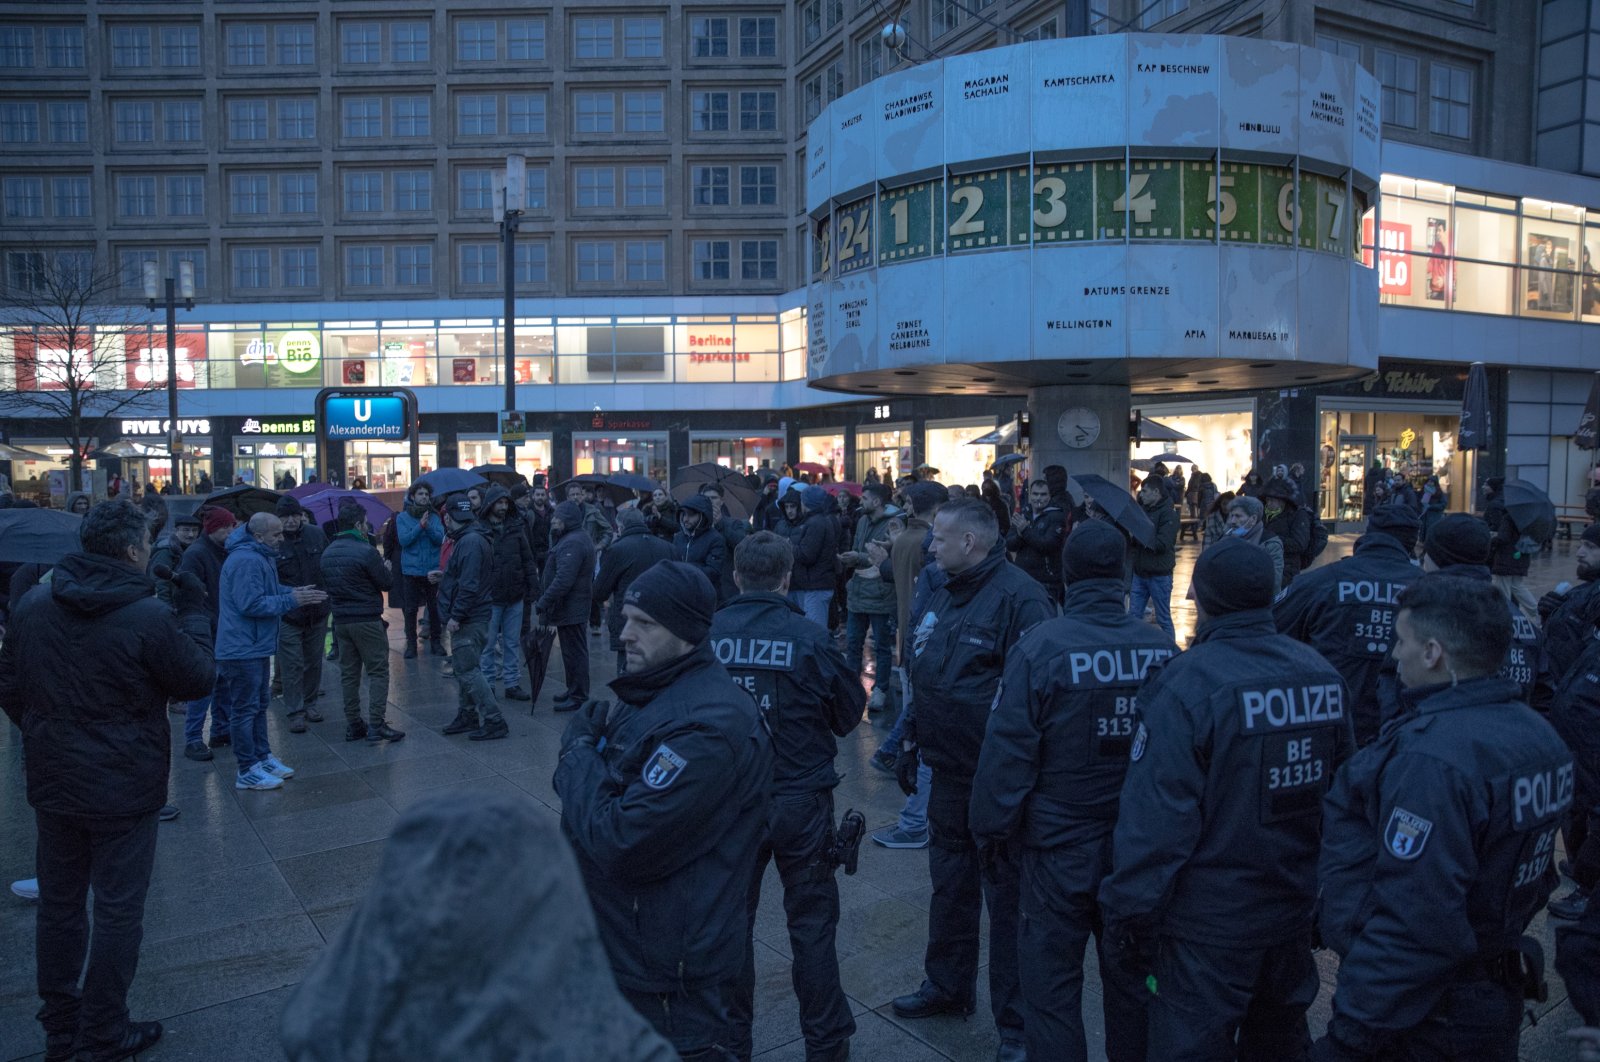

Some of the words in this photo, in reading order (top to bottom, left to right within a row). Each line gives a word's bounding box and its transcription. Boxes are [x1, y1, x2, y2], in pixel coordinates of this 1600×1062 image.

[1137, 63, 1157, 73] KAP
[1160, 64, 1211, 75] DESCHNEW
[964, 73, 1009, 90] MAGADAN
[1043, 74, 1115, 88] KAMTSCHATKA
[884, 90, 934, 111] CHABAROWSK
[964, 84, 1009, 100] SACHALIN
[1320, 91, 1336, 103] NOME
[884, 101, 934, 121] WLADIWOSTOK
[1312, 99, 1343, 116] FAIRBANKS
[1239, 122, 1281, 134] HONOLULU
[1310, 110, 1345, 127] ANCHORAGE
[1032, 177, 1068, 228] 3
[1113, 173, 1157, 224] 4
[1206, 175, 1238, 226] 5
[1277, 182, 1303, 234] 6
[949, 186, 985, 237] 2
[1327, 191, 1345, 241] 7
[890, 199, 909, 245] 1
[840, 208, 870, 262] 24
[1083, 286, 1126, 296] DATUMS
[1129, 286, 1170, 296] GRENZE
[896, 319, 923, 330] SYDNEY
[1046, 319, 1113, 330] WELLINGTON
[1184, 329, 1206, 339] APIA
[890, 329, 929, 341] CANBERRA
[1229, 330, 1278, 341] MARQUESAS
[889, 338, 931, 352] MELBOURNE
[1384, 370, 1441, 394] Tchibo
[354, 399, 372, 422] U
[122, 420, 161, 434] FIVE
[328, 423, 402, 436] Alexanderplatz
[1337, 580, 1407, 605] POLIZ
[1369, 608, 1393, 625] BE
[709, 637, 794, 668] OLIZEI
[1510, 647, 1526, 666] BE
[1069, 648, 1173, 685] POLIZ
[1243, 683, 1344, 729] POLIZEI
[1096, 716, 1133, 737] 313
[1287, 736, 1313, 764] BE
[1268, 758, 1324, 790] 31313
